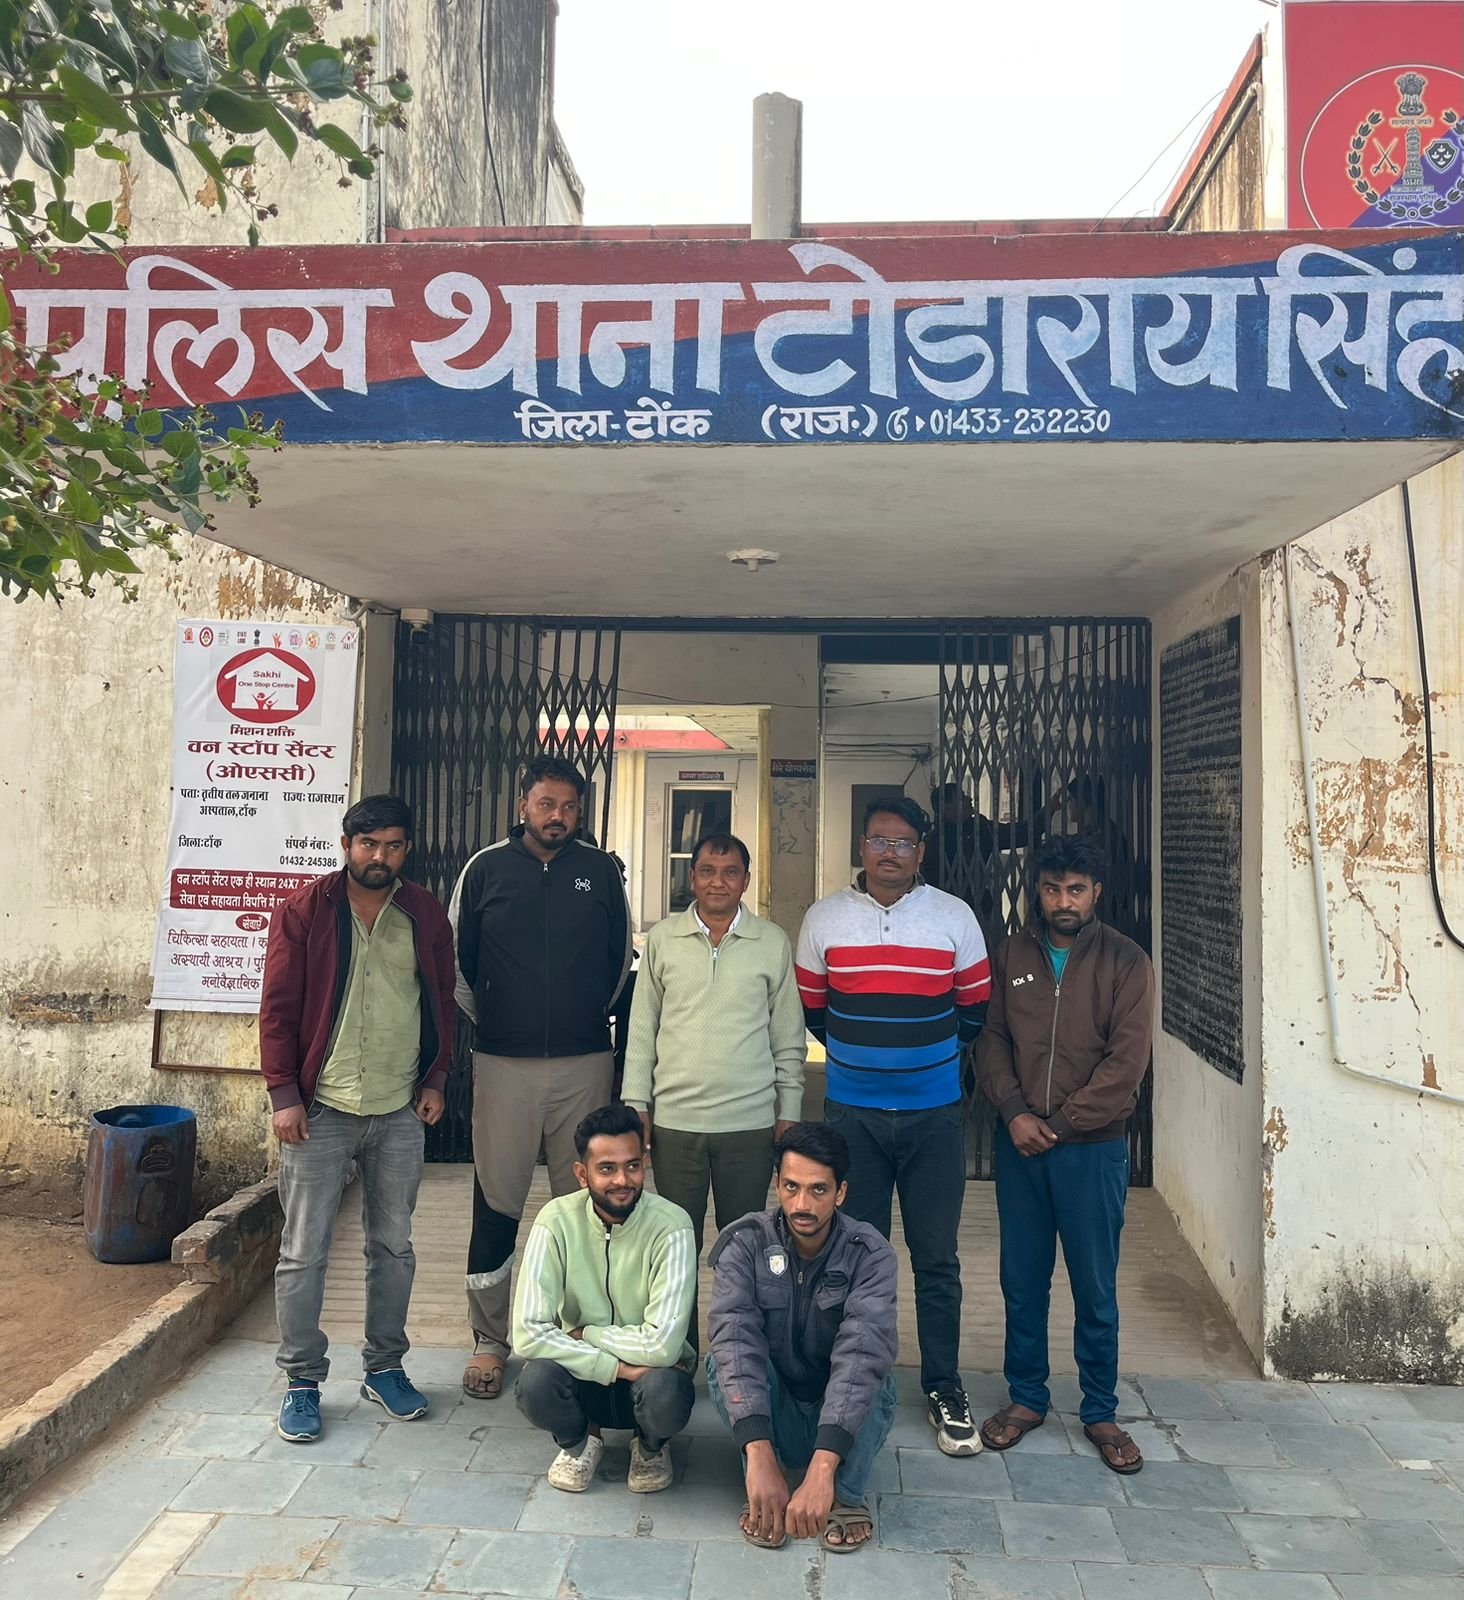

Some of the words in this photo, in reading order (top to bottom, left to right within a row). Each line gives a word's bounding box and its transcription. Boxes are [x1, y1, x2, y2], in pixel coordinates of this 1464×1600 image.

[410, 270, 745, 398] थाना
[930, 408, 1111, 434] 01433-232230
[230, 724, 264, 736] मिशन
[267, 726, 295, 737] शक्ति
[188, 741, 222, 754] वन
[227, 740, 280, 756] स्टॉप
[285, 741, 336, 759] सेंटर
[206, 760, 315, 785] (ओएससी)
[202, 789, 224, 802] तृतीय
[241, 790, 269, 801] जनाना
[308, 793, 345, 804] राजस्थान
[285, 836, 308, 850] संपर्क
[280, 856, 337, 867] 01432-245386
[177, 874, 189, 885] वन
[192, 871, 209, 886] स्टॉप
[212, 871, 228, 887] सेंटर
[230, 876, 243, 888] एक
[245, 872, 253, 888] ही
[255, 877, 276, 888] स्थान
[279, 879, 299, 889] 24X7
[180, 890, 196, 904] सेवा
[198, 891, 210, 906] एवं
[211, 895, 241, 907] सहायता
[243, 894, 267, 908] विपत्ति
[168, 928, 208, 946] चिकित्सा
[211, 934, 248, 948] सहायता
[213, 955, 243, 968] आश्रय
[202, 972, 260, 990] मनोवैज्ञानिक
